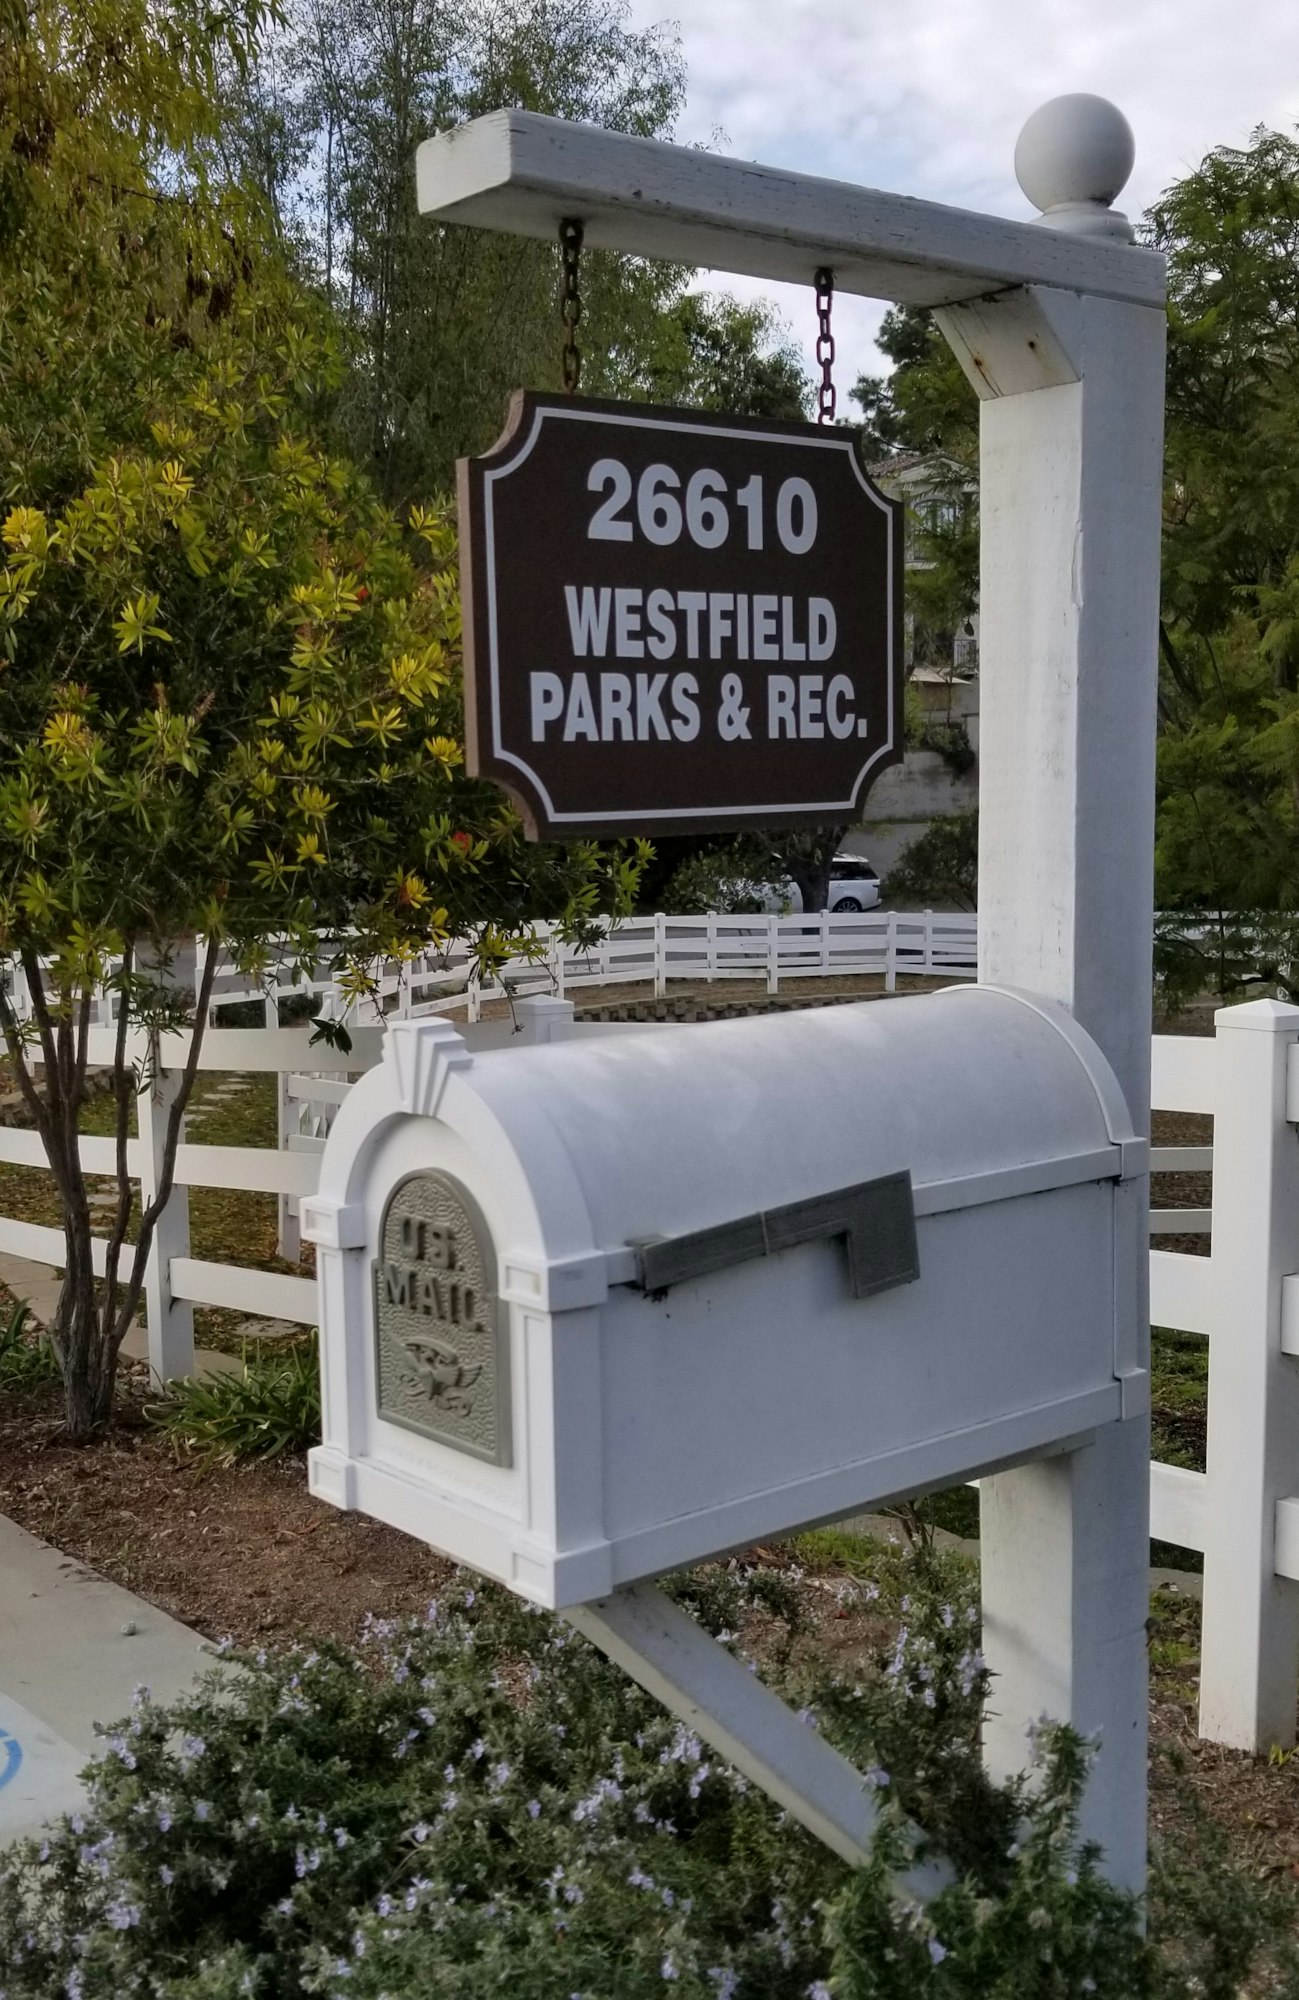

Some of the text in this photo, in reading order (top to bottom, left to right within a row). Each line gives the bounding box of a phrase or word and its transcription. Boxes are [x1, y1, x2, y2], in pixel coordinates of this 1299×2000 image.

[586, 458, 818, 555] 26610
[564, 585, 837, 661] WESTFIELD
[529, 671, 868, 742] PARKS & REC.
[384, 1263, 484, 1332] MAIL
